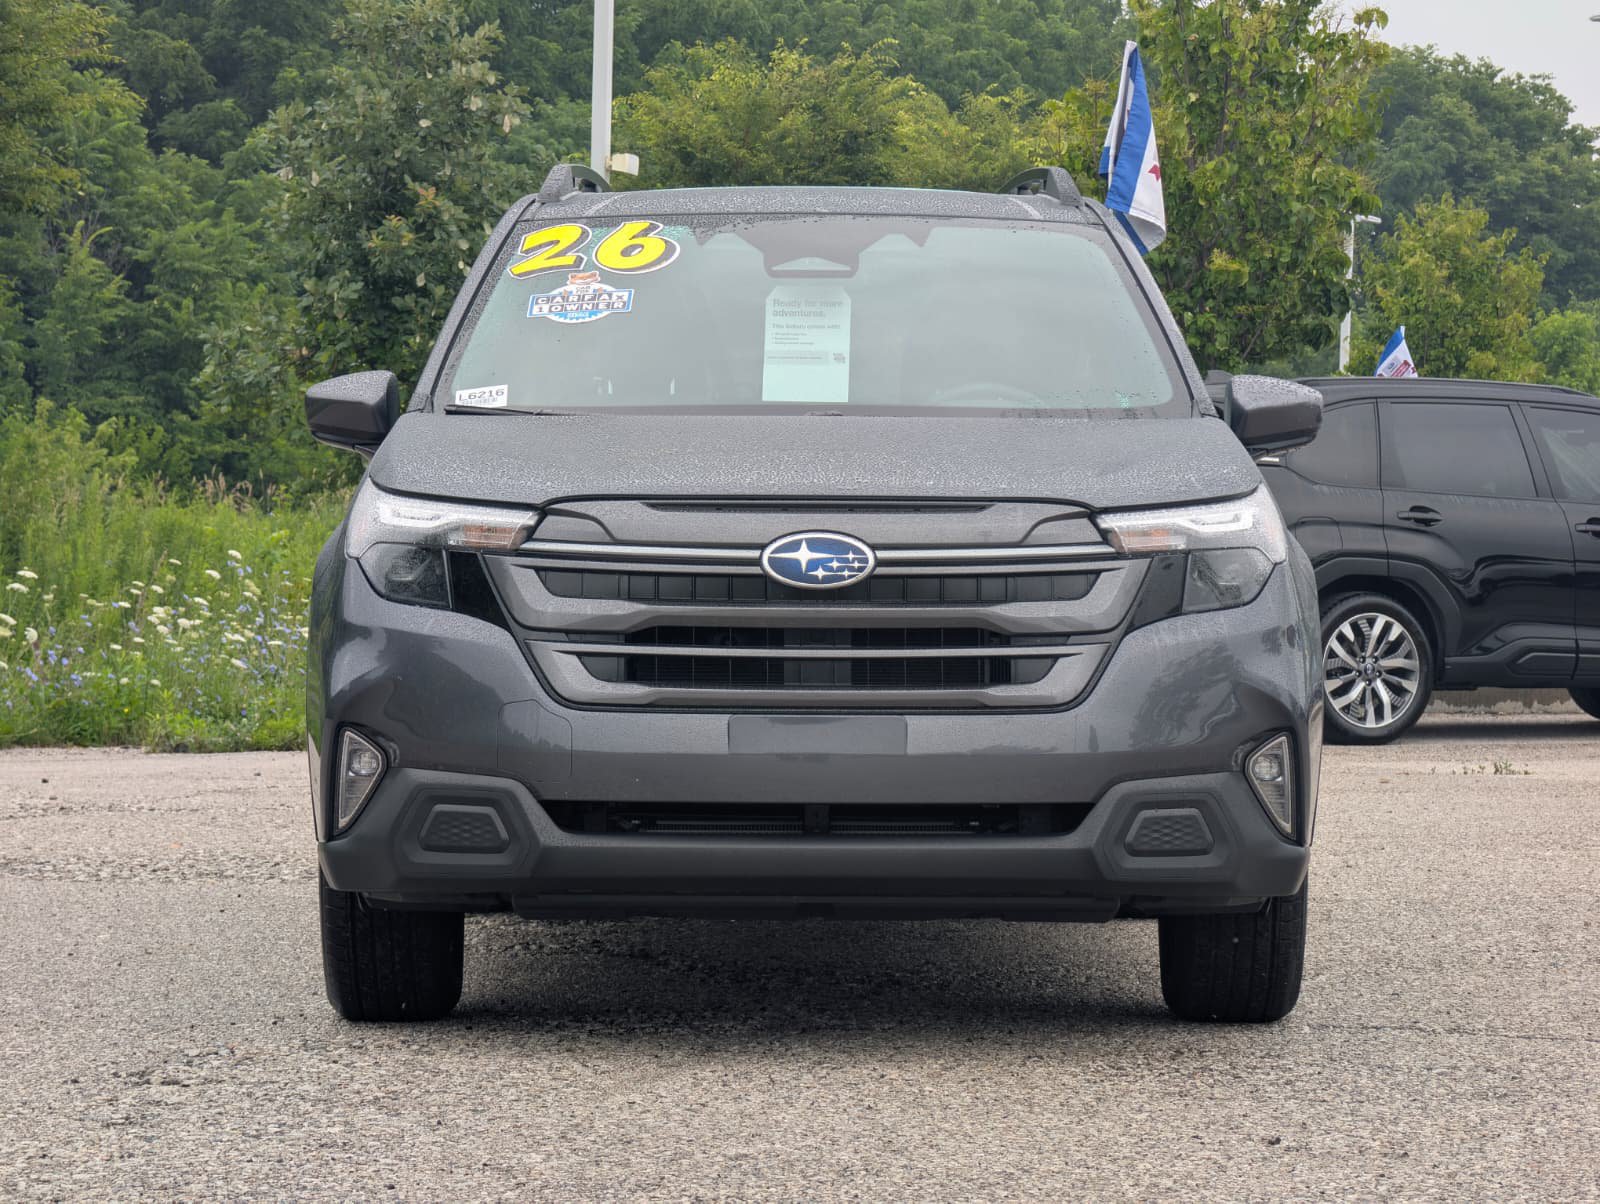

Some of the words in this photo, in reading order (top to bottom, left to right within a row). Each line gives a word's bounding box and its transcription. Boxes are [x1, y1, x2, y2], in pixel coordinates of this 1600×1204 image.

[509, 221, 680, 278] 26
[536, 292, 627, 305] CARFAX
[550, 301, 625, 312] OWNER
[458, 389, 505, 401] L6216
